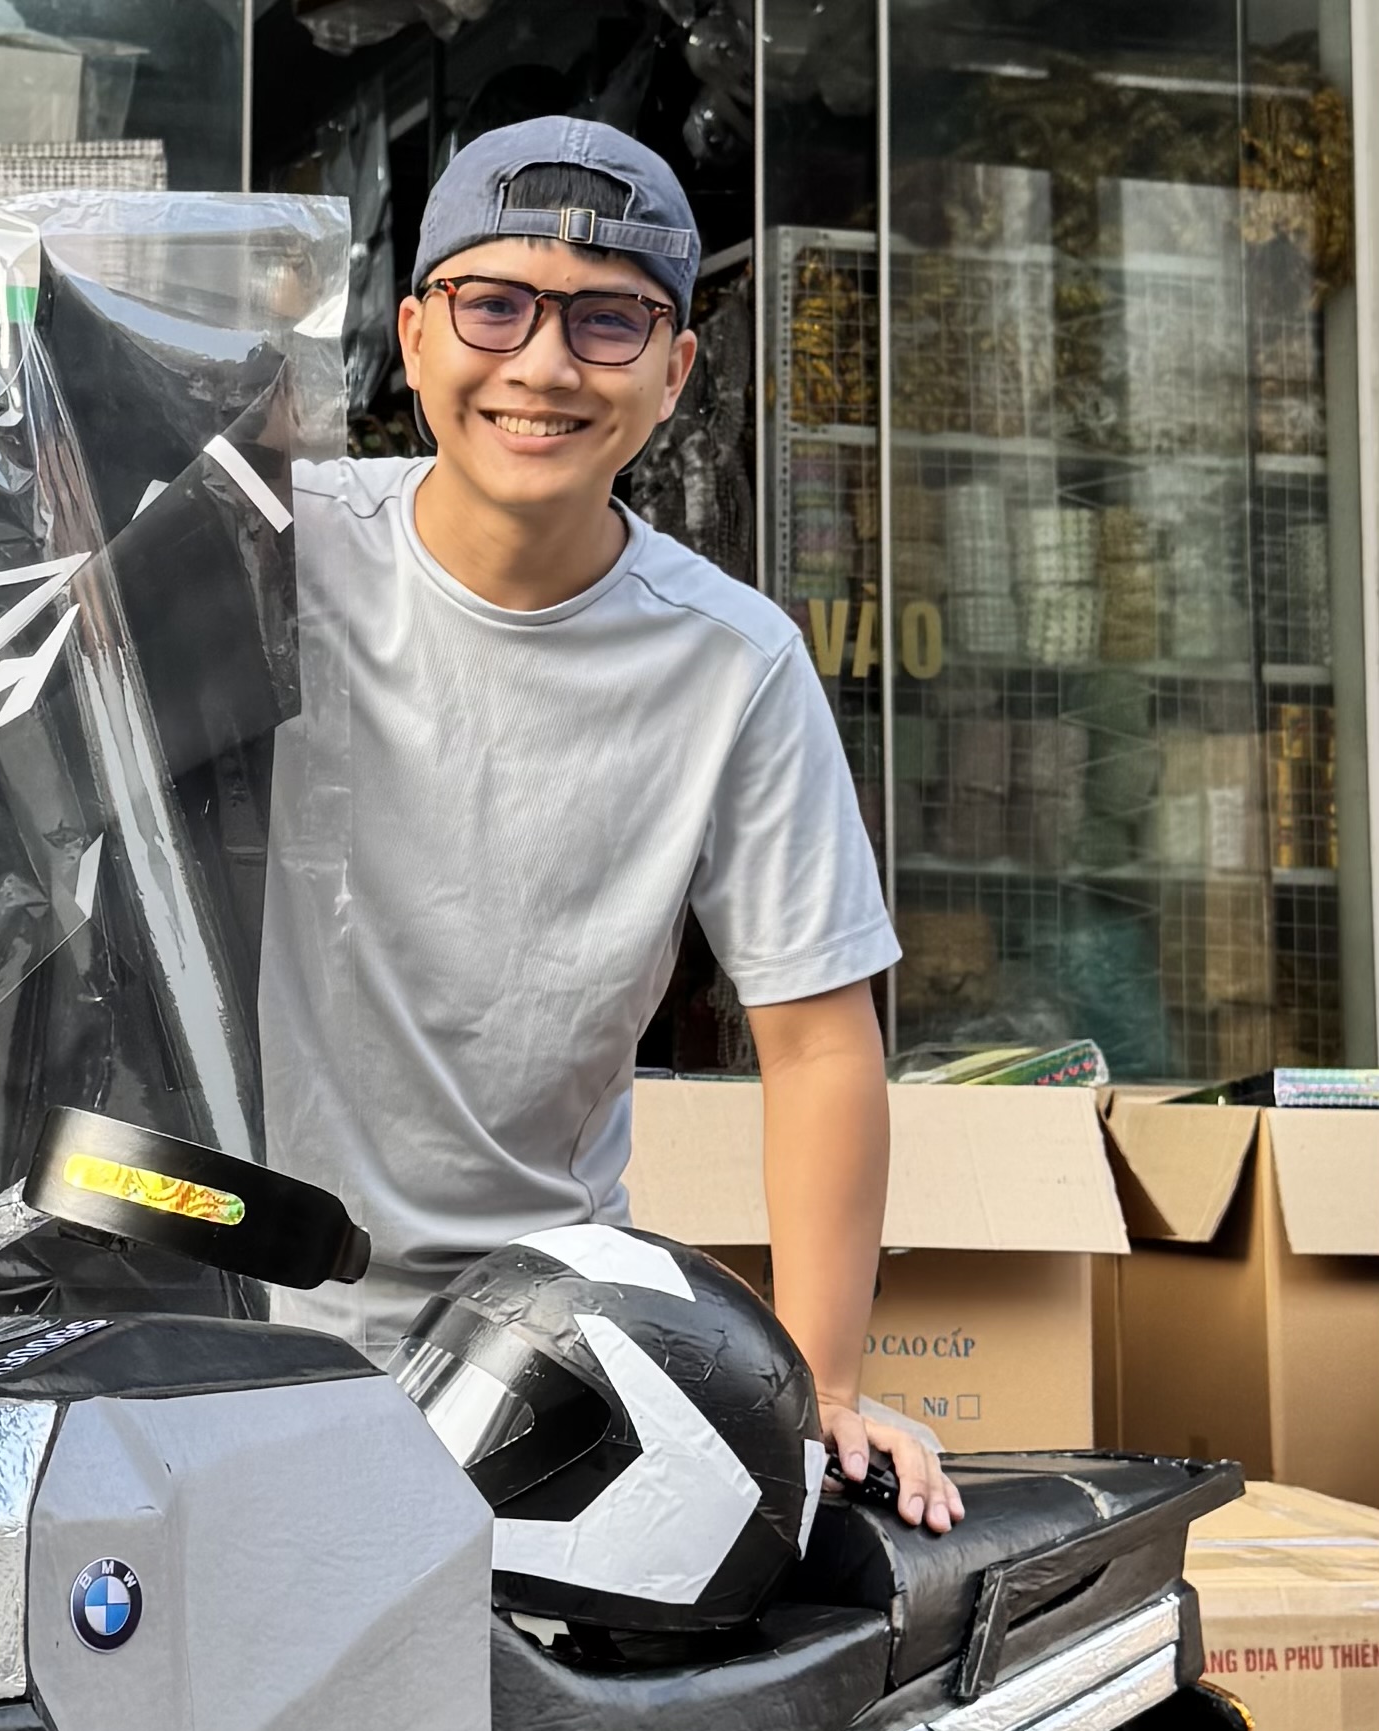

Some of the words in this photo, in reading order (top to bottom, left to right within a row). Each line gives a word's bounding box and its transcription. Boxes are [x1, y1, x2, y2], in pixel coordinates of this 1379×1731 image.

[863, 1334, 876, 1355] O
[882, 1334, 927, 1356] CAO
[933, 1326, 975, 1358] CẤP
[923, 1396, 948, 1417] Nữ
[79, 1560, 137, 1590] BMW
